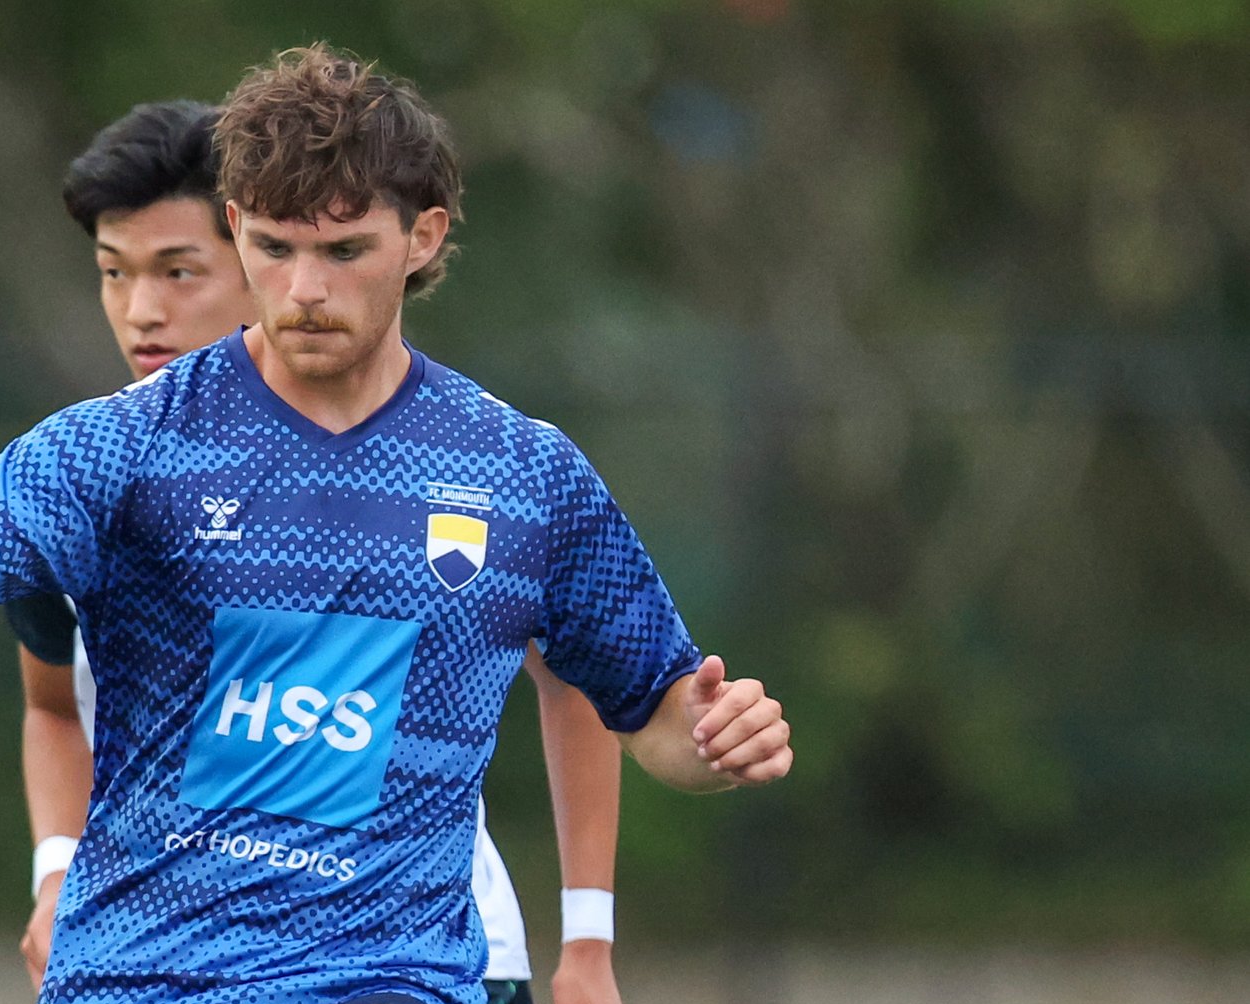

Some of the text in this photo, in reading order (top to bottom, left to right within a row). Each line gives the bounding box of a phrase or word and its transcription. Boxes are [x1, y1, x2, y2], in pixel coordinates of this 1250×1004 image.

[429, 487, 490, 505] FC MONMOUTH
[194, 526, 242, 540] hummel
[215, 678, 377, 752] HSS
